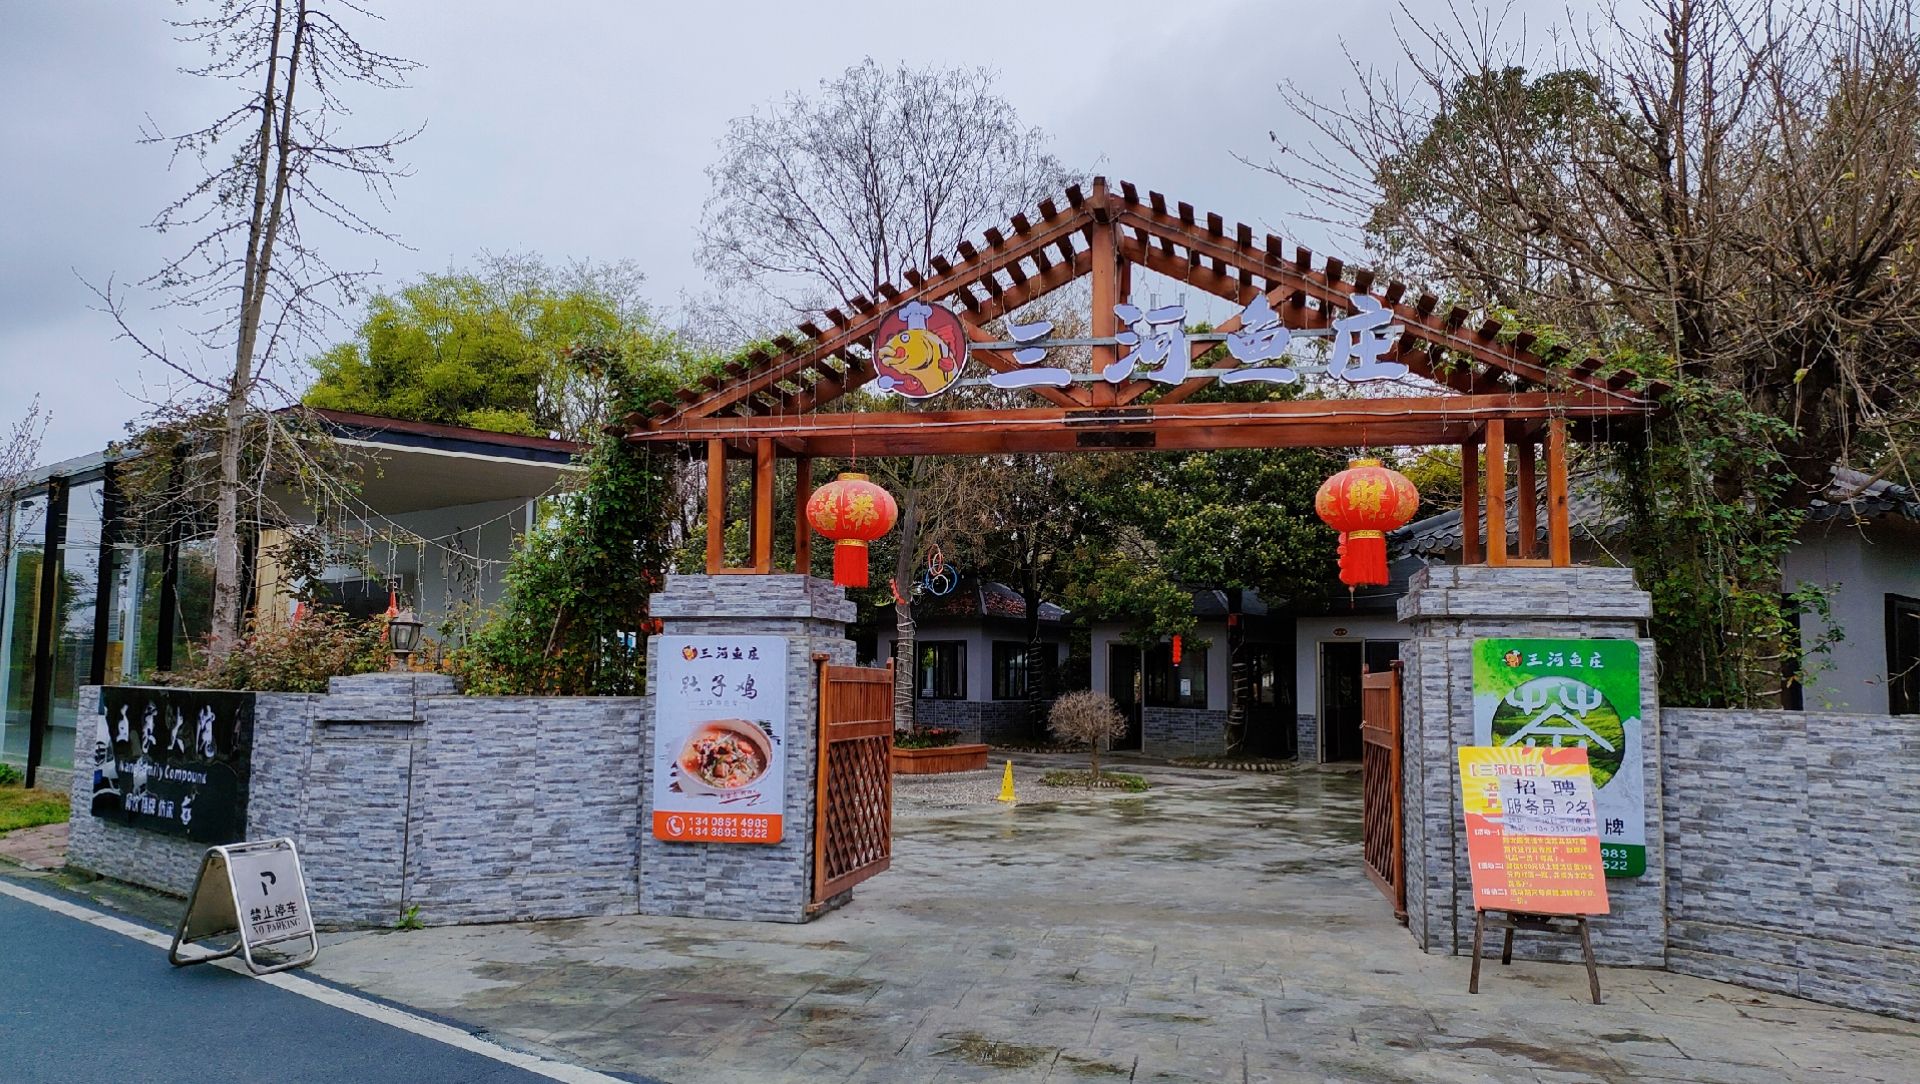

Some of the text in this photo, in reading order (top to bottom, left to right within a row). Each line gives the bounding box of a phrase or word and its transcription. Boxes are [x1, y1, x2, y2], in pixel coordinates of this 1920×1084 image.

[986, 294, 1410, 389] 三河鱼庄
[699, 646, 760, 661] 三河鱼庄
[1526, 651, 1604, 668] 三河鱼庄
[688, 817, 708, 826] 134
[1605, 818, 1625, 836] 牌
[688, 827, 708, 837] 134
[250, 901, 298, 922] 禁止停车
[252, 918, 302, 936] NO PARKING
